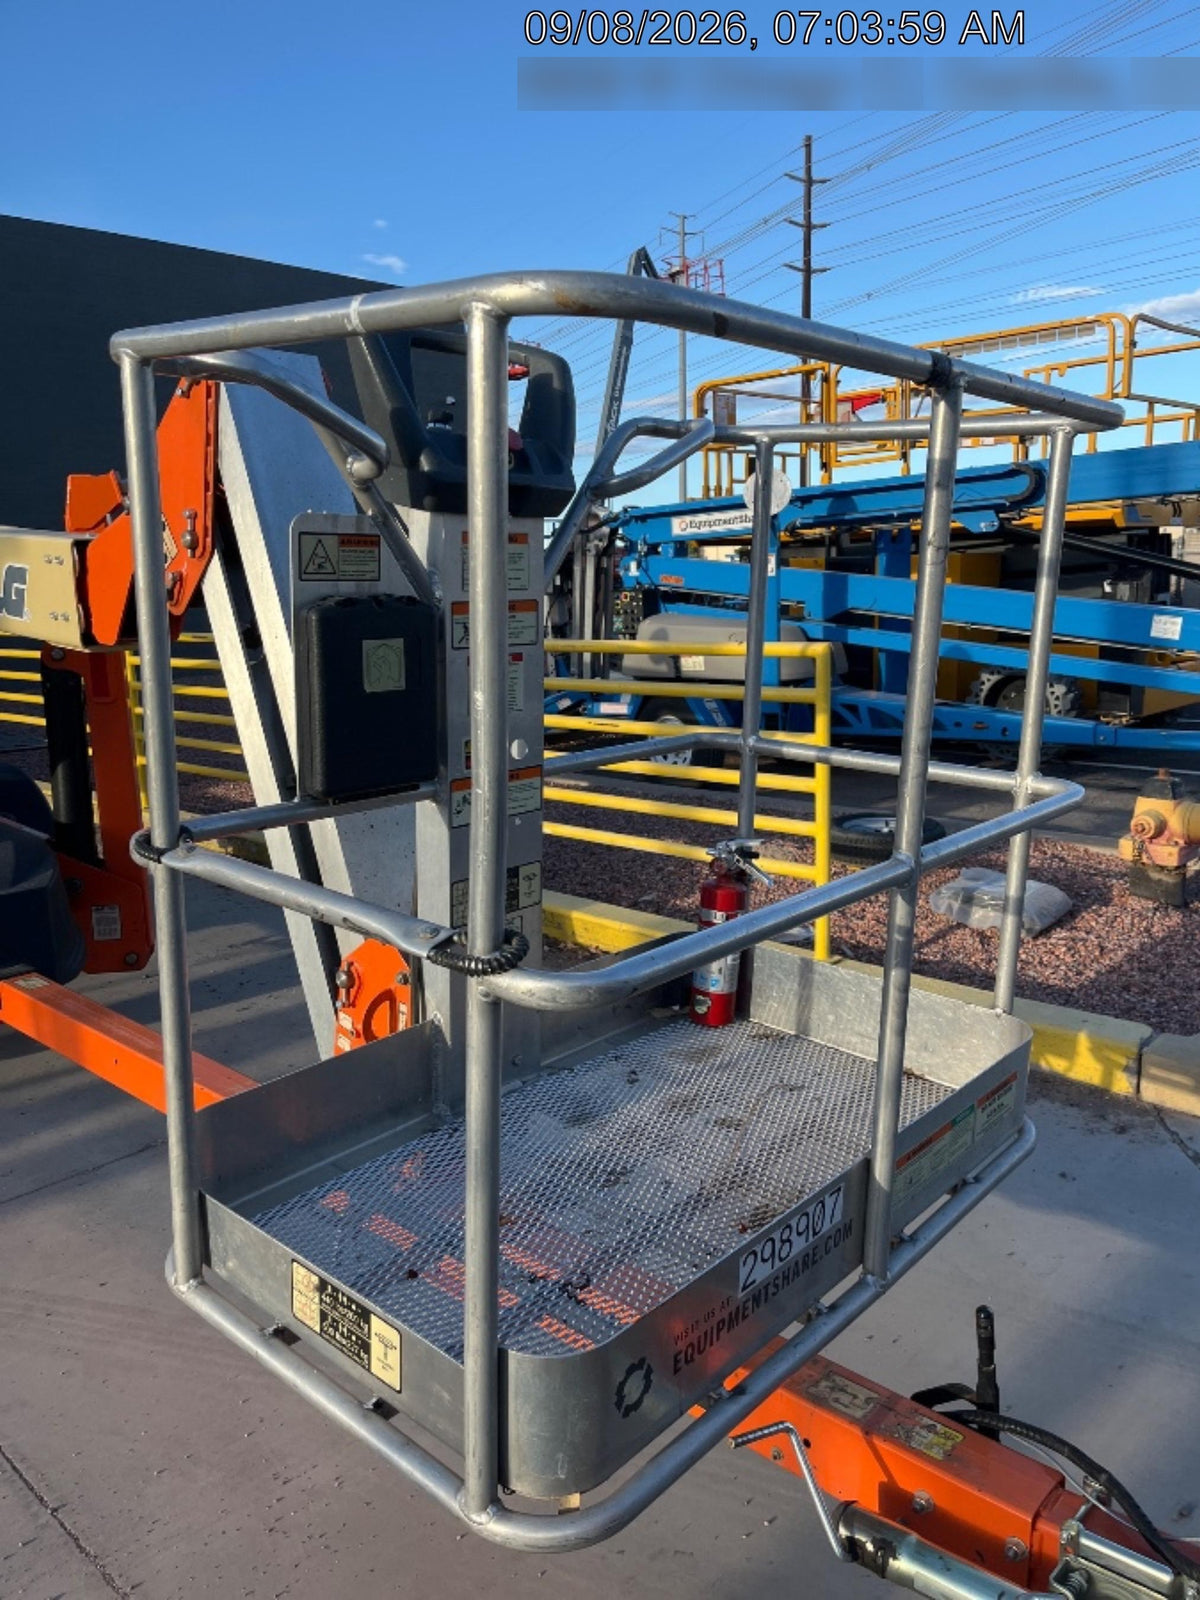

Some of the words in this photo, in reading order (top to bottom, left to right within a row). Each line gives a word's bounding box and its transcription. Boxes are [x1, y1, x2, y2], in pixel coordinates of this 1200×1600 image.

[0, 563, 30, 621] G
[740, 1186, 842, 1293] 298907
[673, 1218, 854, 1376] EQUIPMENTSHARE.COM
[674, 1319, 699, 1346] VISIT
